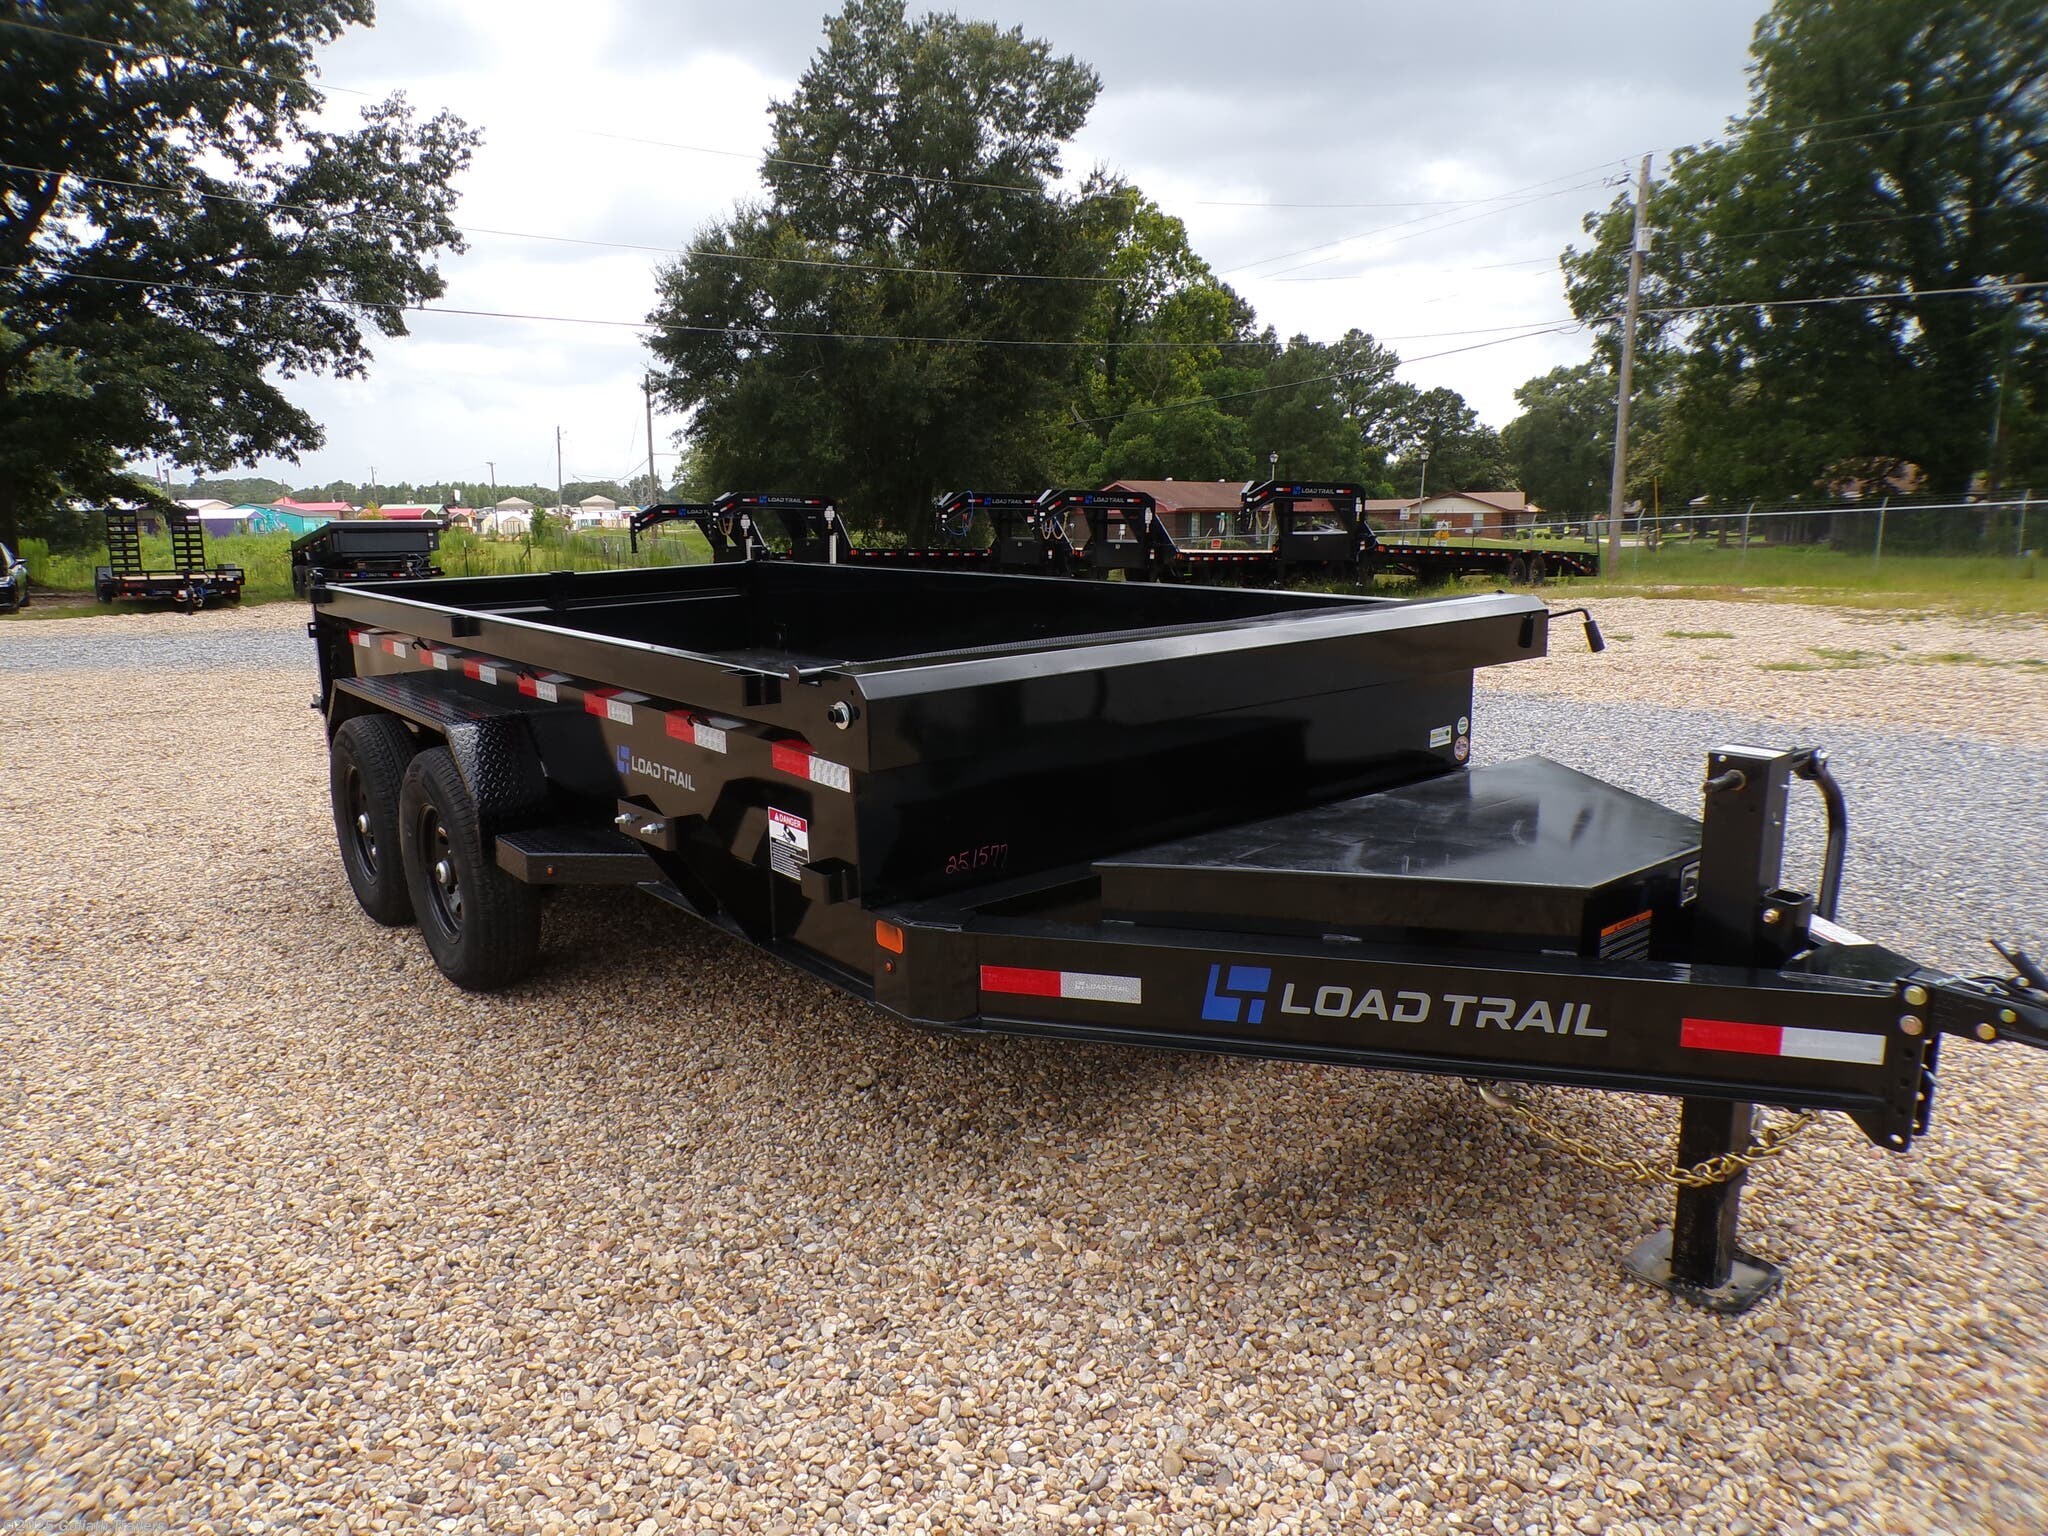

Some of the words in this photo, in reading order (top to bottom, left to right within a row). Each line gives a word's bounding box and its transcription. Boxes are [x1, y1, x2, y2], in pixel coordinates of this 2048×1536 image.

[631, 755, 661, 779] LOAD
[662, 765, 696, 792] TRAIL
[779, 812, 802, 829] DANGER
[945, 843, 1008, 875] 251577
[1280, 982, 1432, 1023] LOAD
[1443, 994, 1608, 1038] TRAIL
